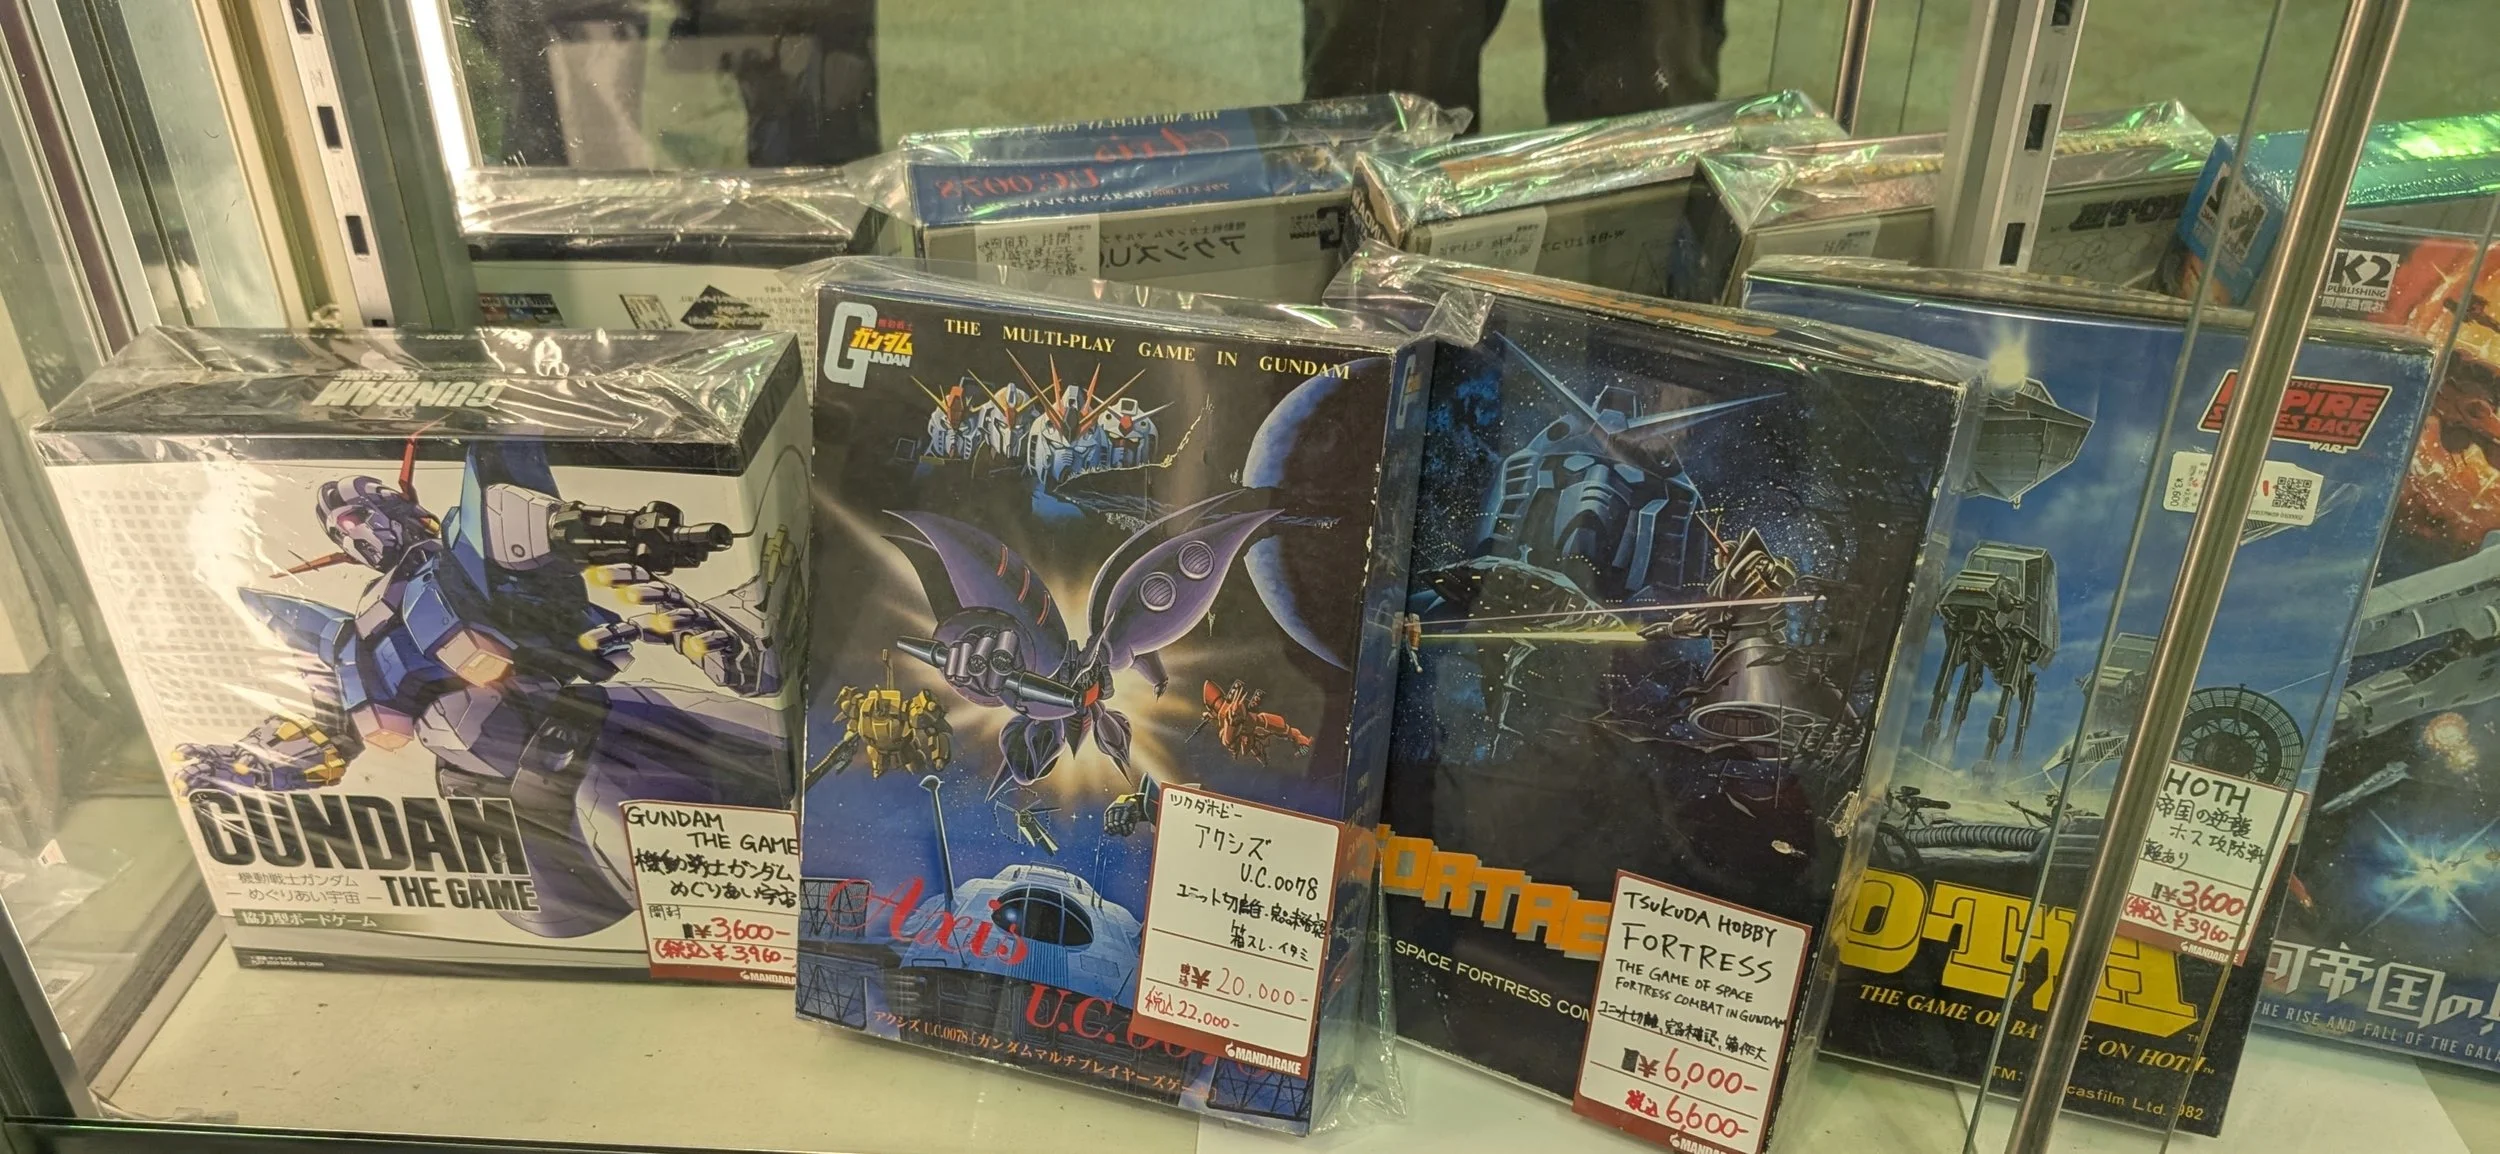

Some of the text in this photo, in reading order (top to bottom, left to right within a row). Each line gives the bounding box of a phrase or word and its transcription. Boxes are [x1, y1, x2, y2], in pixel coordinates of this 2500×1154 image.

[2330, 252, 2392, 288] K2
[2327, 285, 2387, 298] PUBLISHING
[850, 327, 914, 356] ガンダム
[944, 318, 1351, 381] THE MULTI-PLAY GAME IN GUNDAM
[310, 380, 506, 408] GUNDAM
[2307, 416, 2363, 437] BACK
[2163, 767, 2251, 813] HOTH
[189, 788, 531, 878] GUNDAM
[626, 806, 725, 832] GUNDAM
[687, 832, 799, 855] THE GAME
[1194, 823, 1272, 861] アクシズ
[238, 871, 359, 888] 機動戦士ガンダム
[380, 875, 541, 913] THE GAME
[1240, 862, 1319, 901] U.C.0078
[1376, 824, 1612, 962] ORTRE
[243, 910, 377, 929] 協力型ボードゲーム
[827, 875, 1030, 966] Axis
[1623, 891, 1778, 948] TSUKUDA HOBBY
[1621, 921, 1773, 985] FORTRESS
[2186, 941, 2239, 963] MANDARAE
[750, 971, 796, 986] MANDARA
[1394, 939, 1453, 972] SPACE
[1456, 961, 1553, 1009] FORTRESS
[1615, 958, 1754, 1003] THE GAME OF SPACE
[1615, 976, 1788, 1030] FORTRESS COMBAT IN GUNDAM
[1859, 983, 1903, 1007] THE
[1907, 994, 1972, 1024] GAME
[2097, 1039, 2136, 1060] ON
[874, 1011, 920, 1034] アクシズ
[2286, 1006, 2319, 1027] RISE
[2326, 1015, 2357, 1034] AND
[2363, 1022, 2398, 1042] FALL
[2405, 1031, 2425, 1046] OF
[2431, 1035, 2459, 1054] THE
[1235, 1046, 1302, 1076] MANDARAKE
[2065, 1083, 2126, 1107] casfilm
[2132, 1097, 2167, 1117] Ltd.
